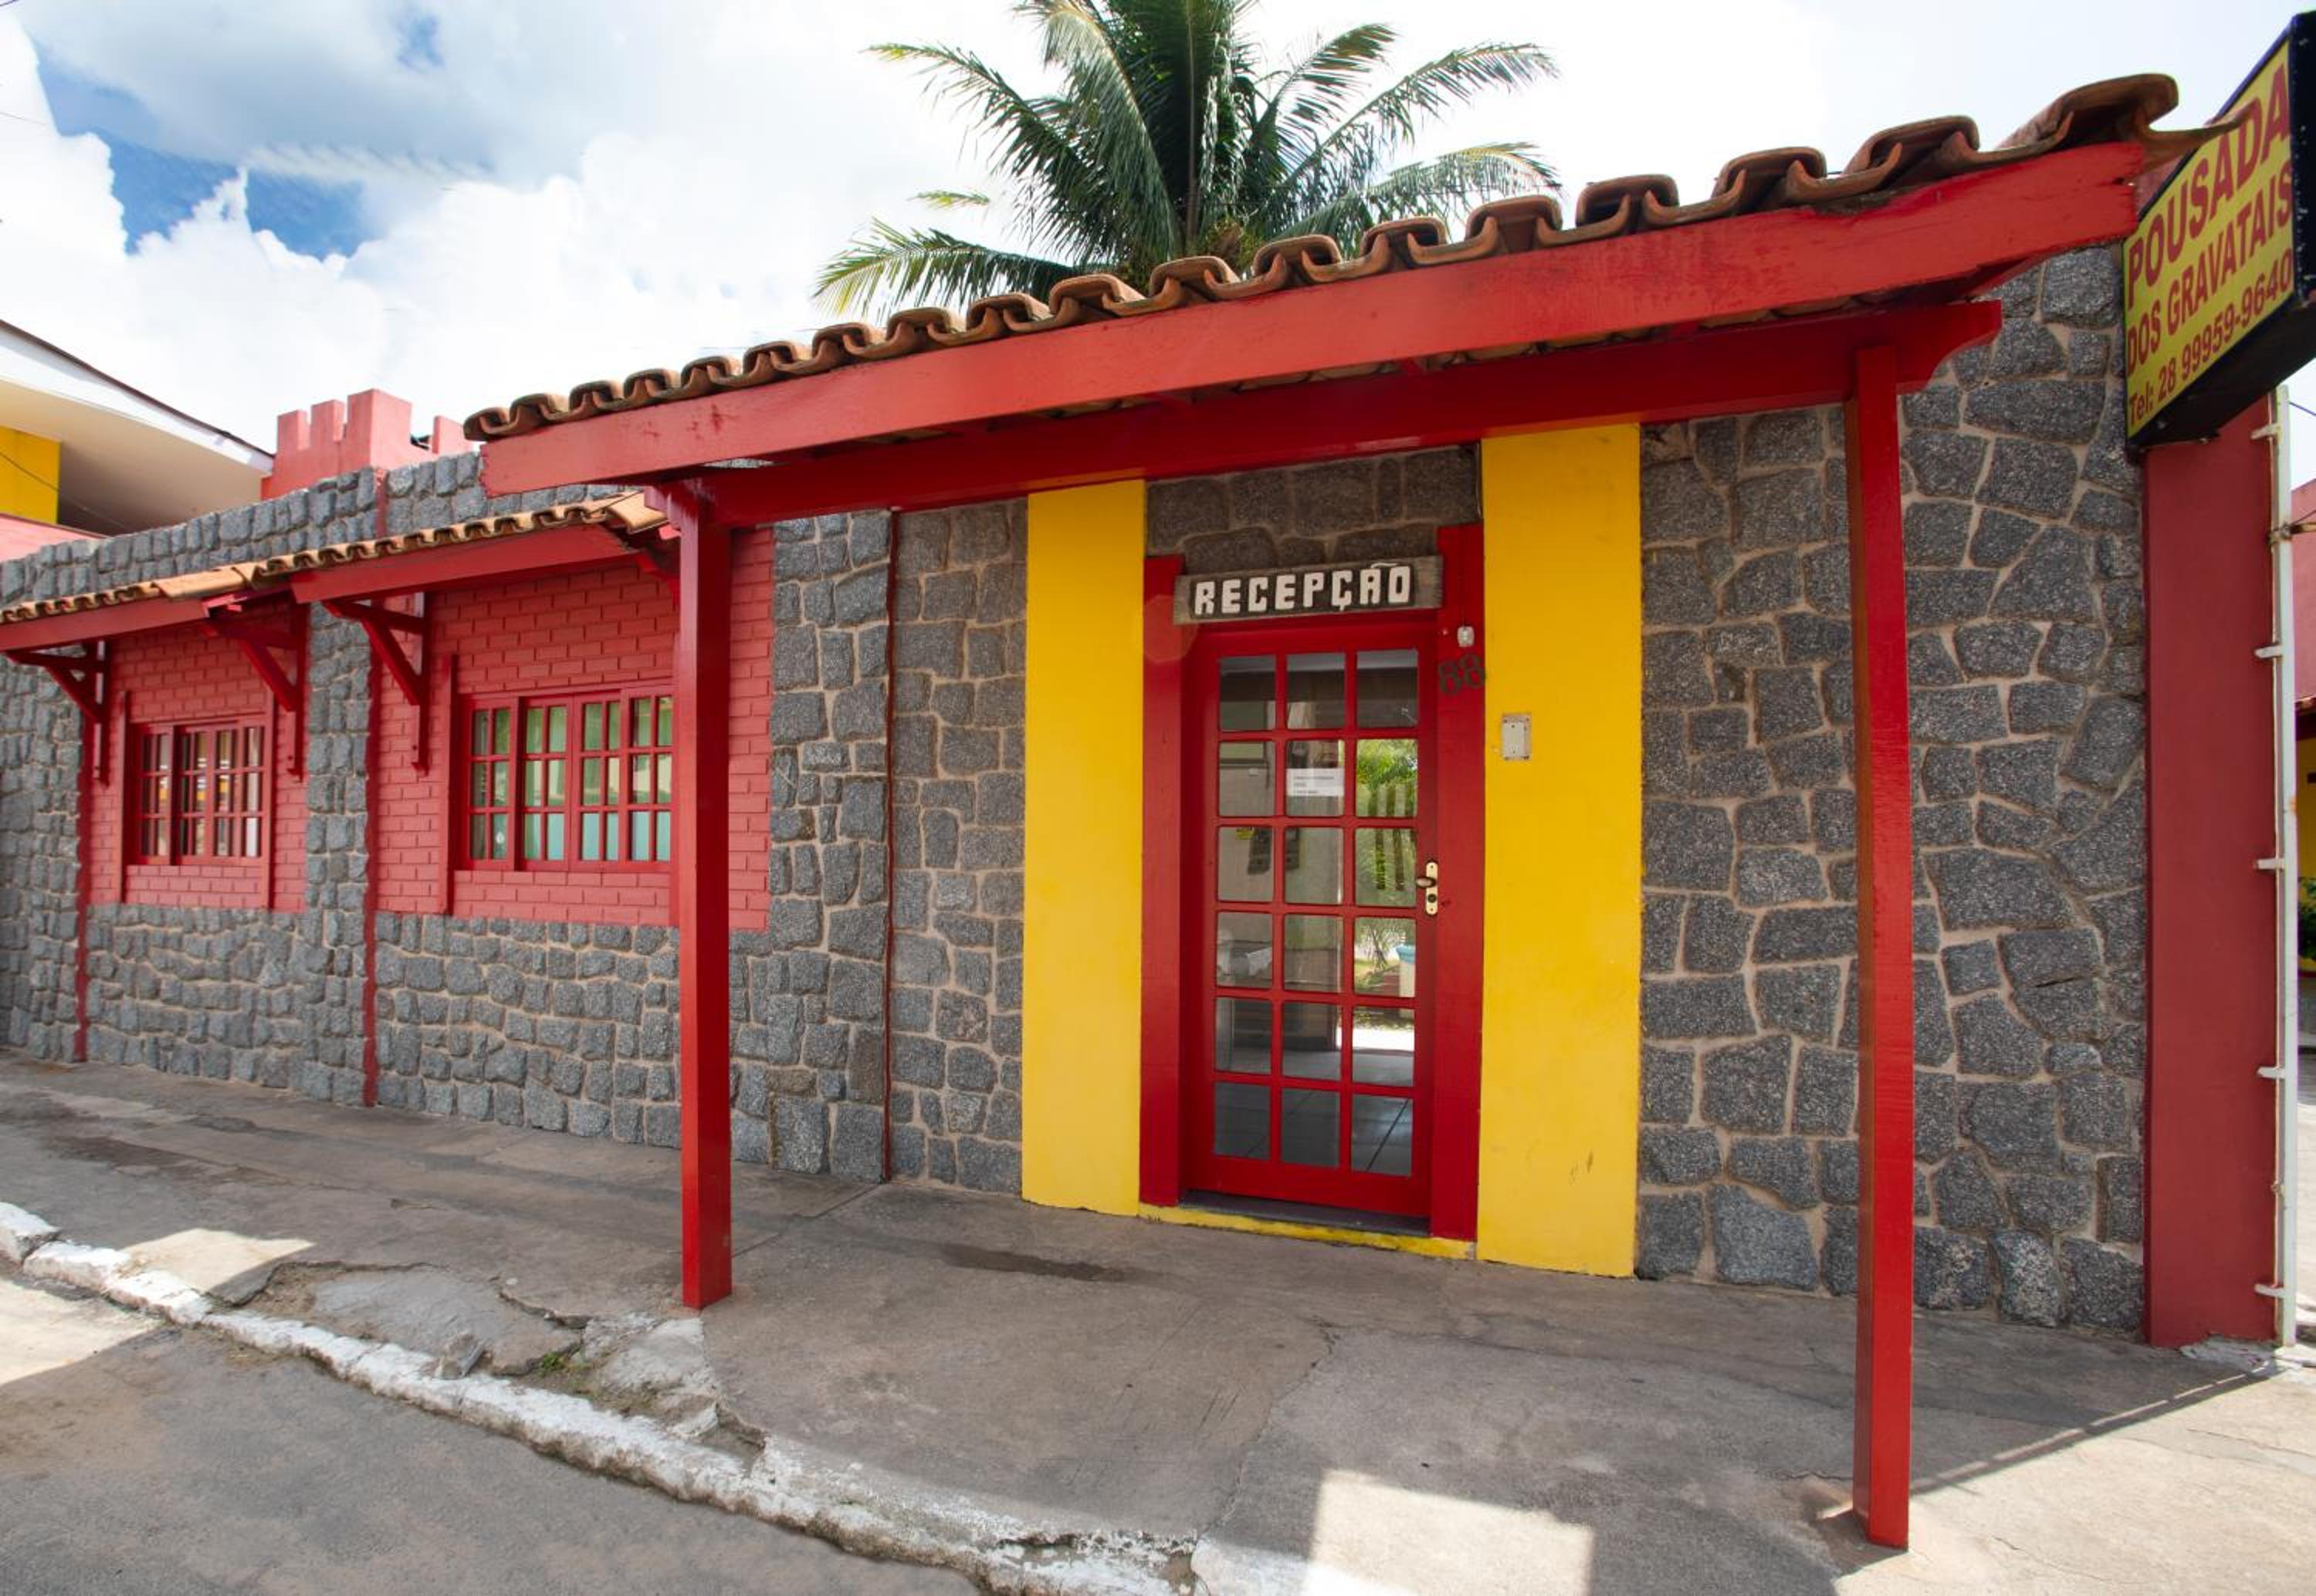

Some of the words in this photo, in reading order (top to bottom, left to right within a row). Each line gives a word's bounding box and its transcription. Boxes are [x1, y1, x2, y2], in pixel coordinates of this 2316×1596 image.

[2127, 297, 2162, 377] DOS
[2167, 159, 2293, 336] GRAVATAIS
[2128, 62, 2291, 310] POUSADA
[2128, 382, 2154, 425] Tel:
[2158, 357, 2177, 402] 28
[2182, 247, 2293, 381] 99959-9640
[1194, 562, 1412, 616] RECEPÇÃO
